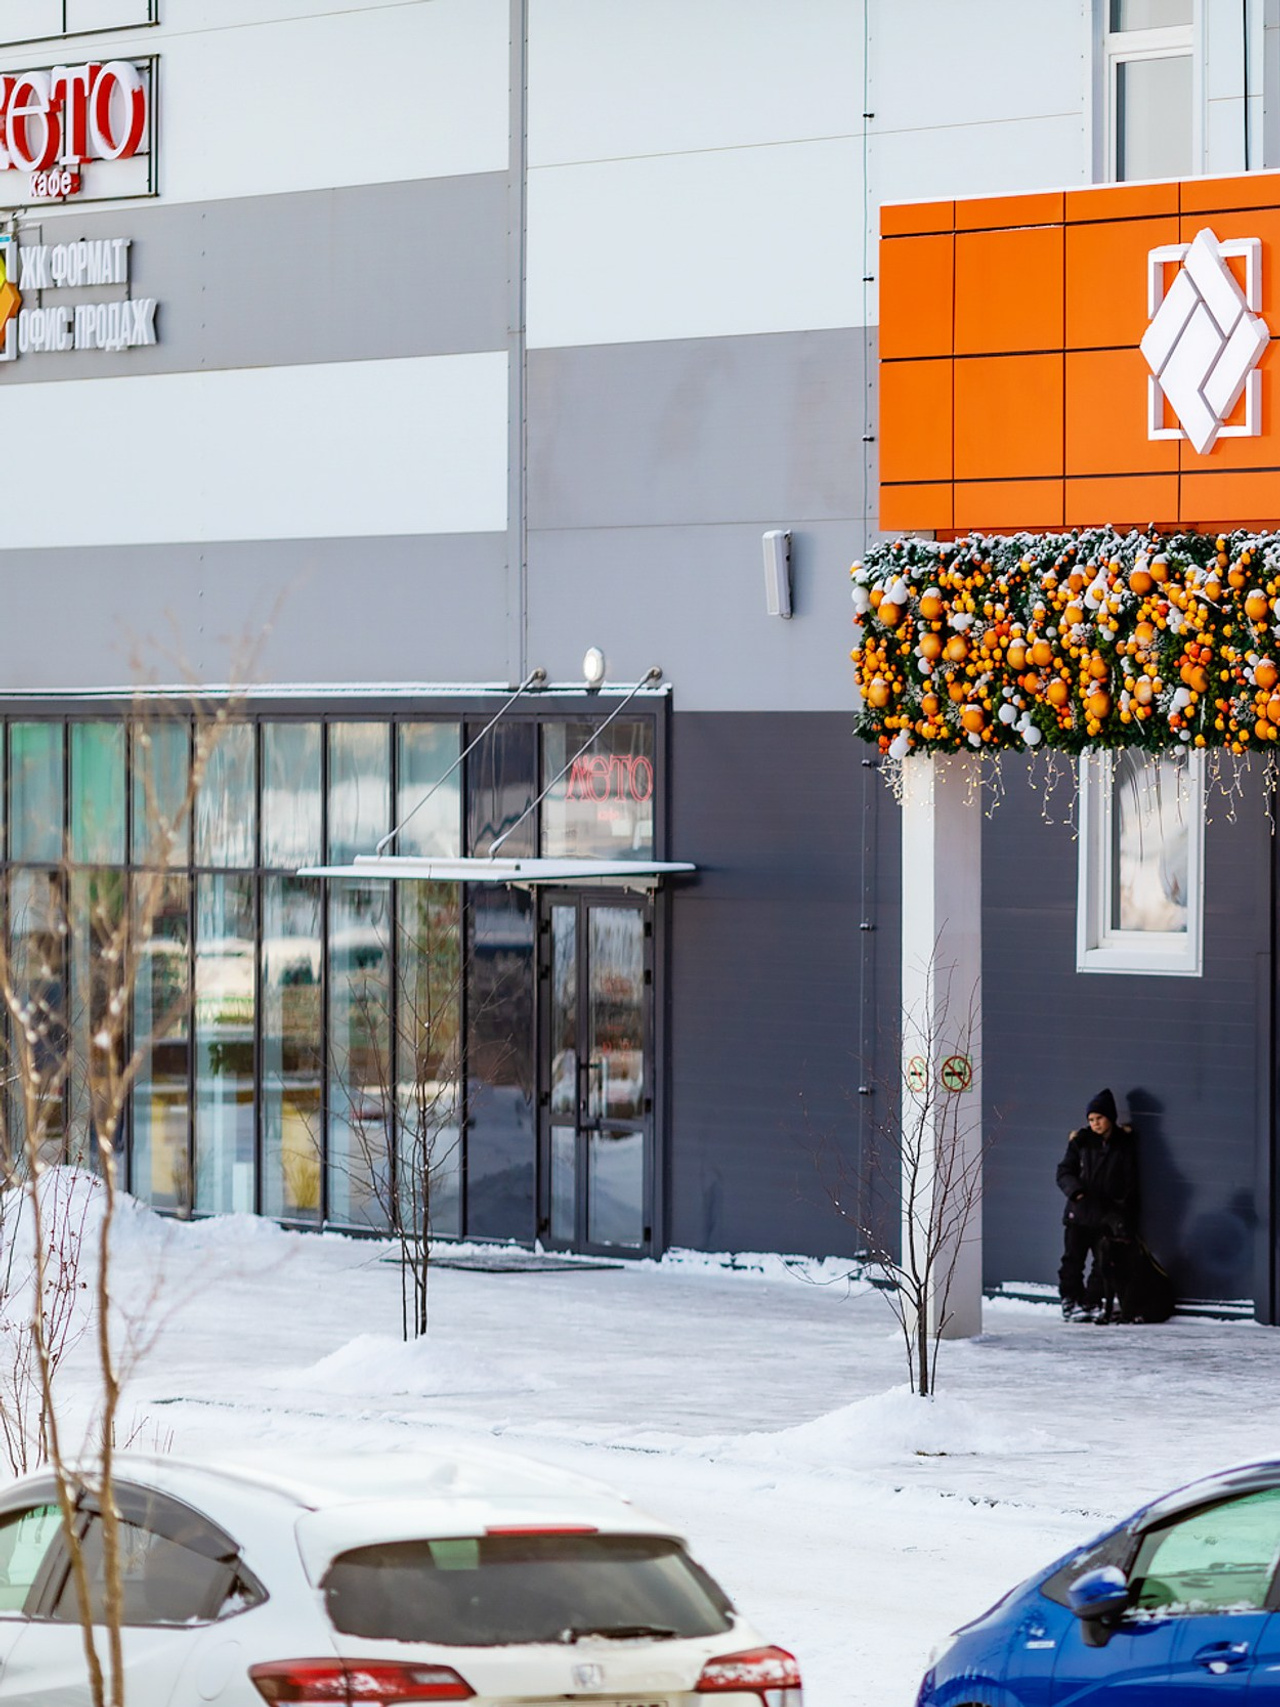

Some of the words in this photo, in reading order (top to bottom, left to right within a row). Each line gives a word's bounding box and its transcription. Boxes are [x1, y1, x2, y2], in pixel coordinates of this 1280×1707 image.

[29, 168, 80, 197] кафе
[19, 245, 50, 290] ЖК
[51, 238, 131, 287] ФОРМАТ
[18, 306, 74, 353] ОФИС
[74, 298, 157, 352] ПРОДАЖ
